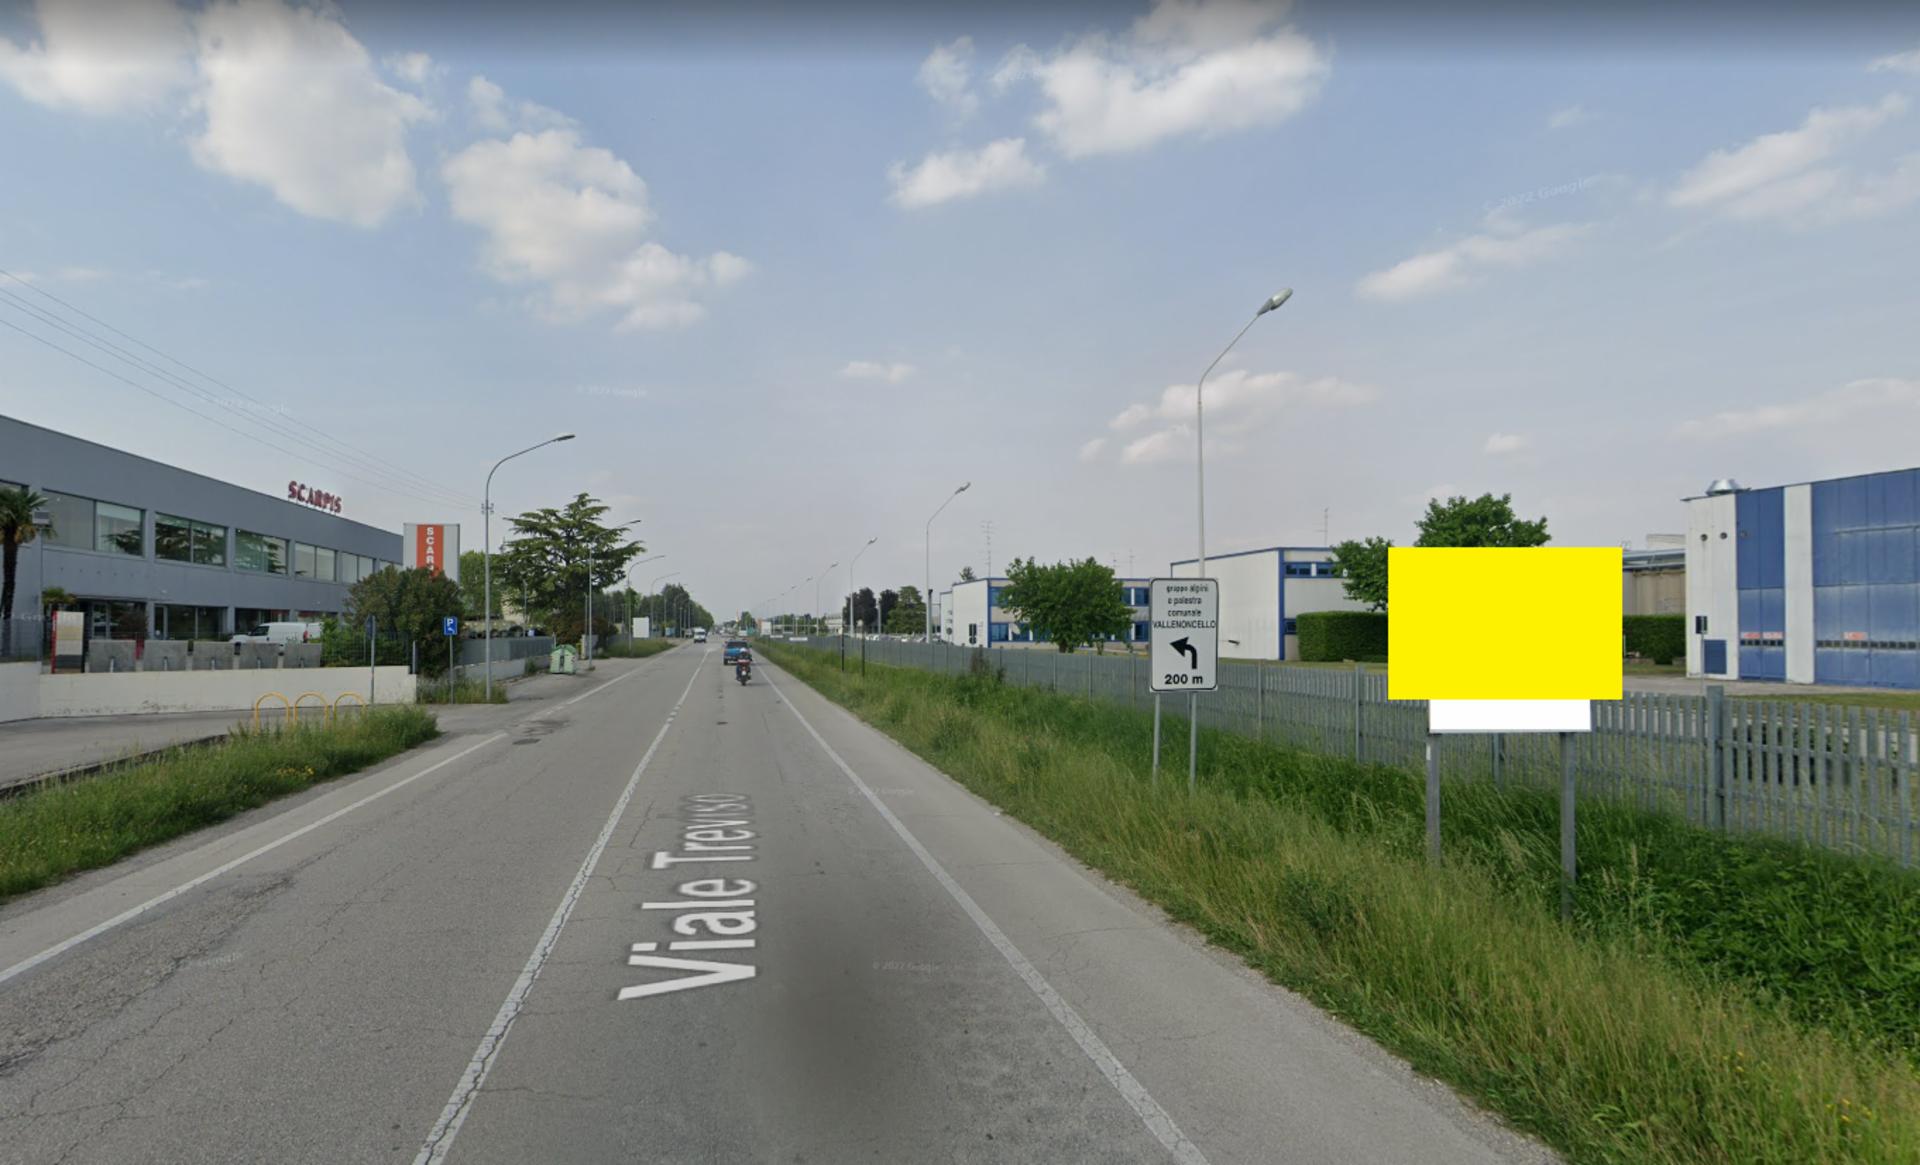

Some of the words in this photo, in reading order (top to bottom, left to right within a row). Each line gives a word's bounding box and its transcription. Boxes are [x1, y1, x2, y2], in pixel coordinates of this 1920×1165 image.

[288, 480, 342, 512] SCARPIS
[1190, 584, 1208, 593] alpini
[1173, 597, 1202, 607] palestra
[1168, 609, 1202, 617] comunale
[447, 618, 454, 626] P
[1153, 620, 1216, 629] VALLENONCELLO
[1165, 674, 1188, 685] 200
[1192, 676, 1203, 684] m
